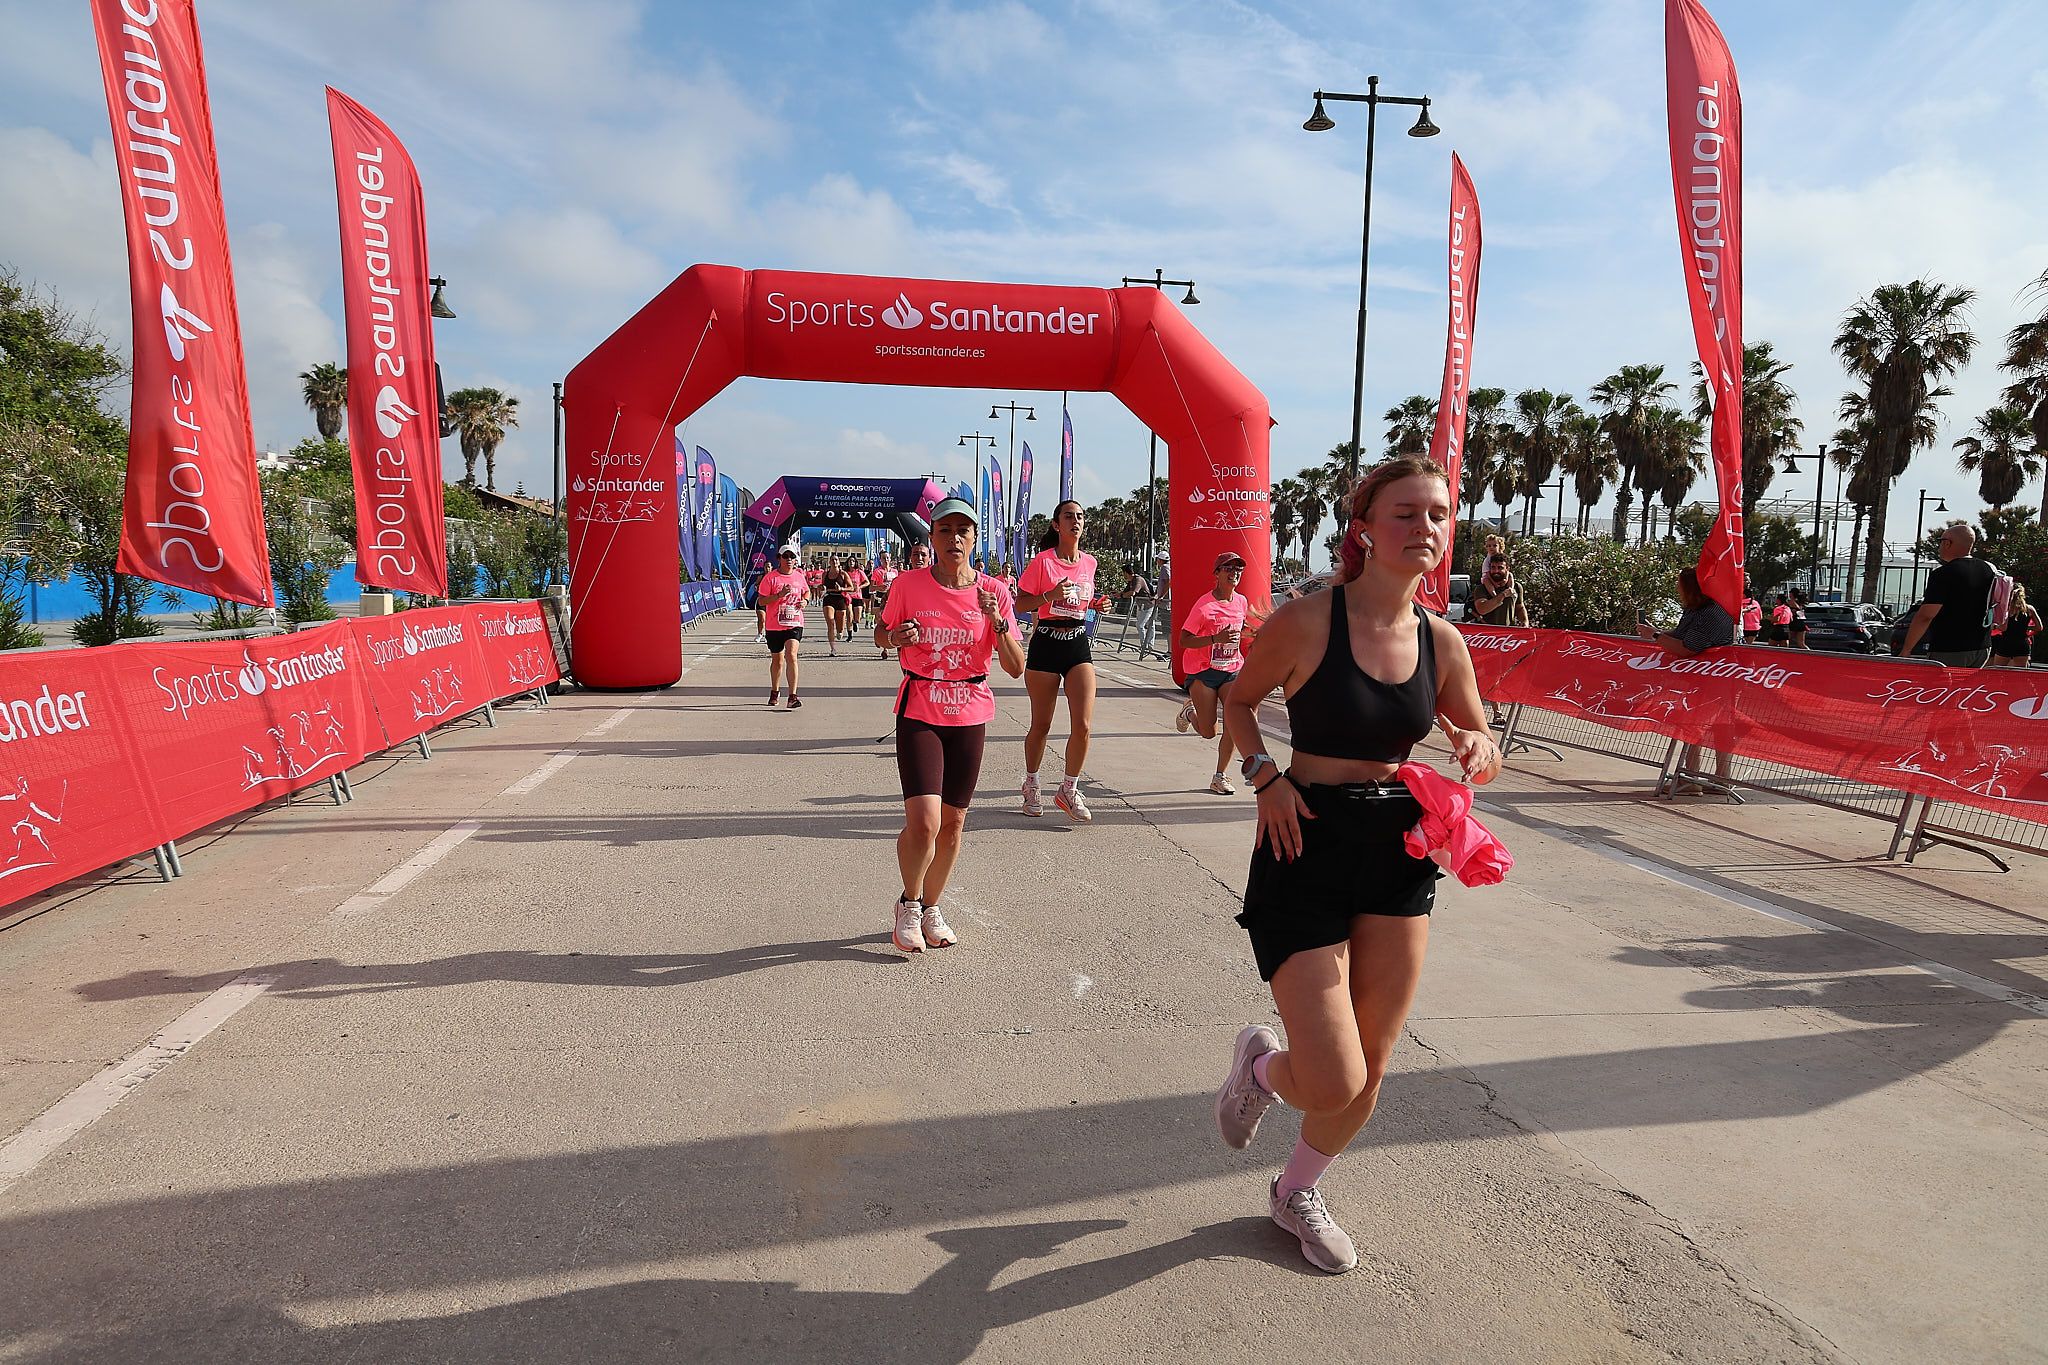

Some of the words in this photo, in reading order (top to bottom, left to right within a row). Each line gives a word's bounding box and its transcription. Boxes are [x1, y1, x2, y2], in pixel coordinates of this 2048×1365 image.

[766, 292, 875, 333] Sports
[929, 301, 1099, 335] Santander
[875, 344, 986, 358] sportssantander.es
[591, 450, 642, 469] Sports
[1212, 464, 1256, 480] Sports
[587, 478, 664, 492] Santander
[1207, 488, 1268, 502] Santander
[808, 510, 884, 519] VOLVO
[915, 610, 941, 618] OYSHO
[477, 613, 506, 643] Sports
[513, 613, 544, 636] Santander
[366, 634, 405, 672] Sports
[416, 620, 464, 652] Santander
[1462, 632, 1528, 653] tander
[1557, 639, 1632, 665] Sports
[1658, 658, 1804, 690] Santander
[153, 665, 239, 720] Sports
[270, 643, 345, 690] Santander
[930, 687, 971, 705] MUJER
[1867, 679, 2009, 713] Sports
